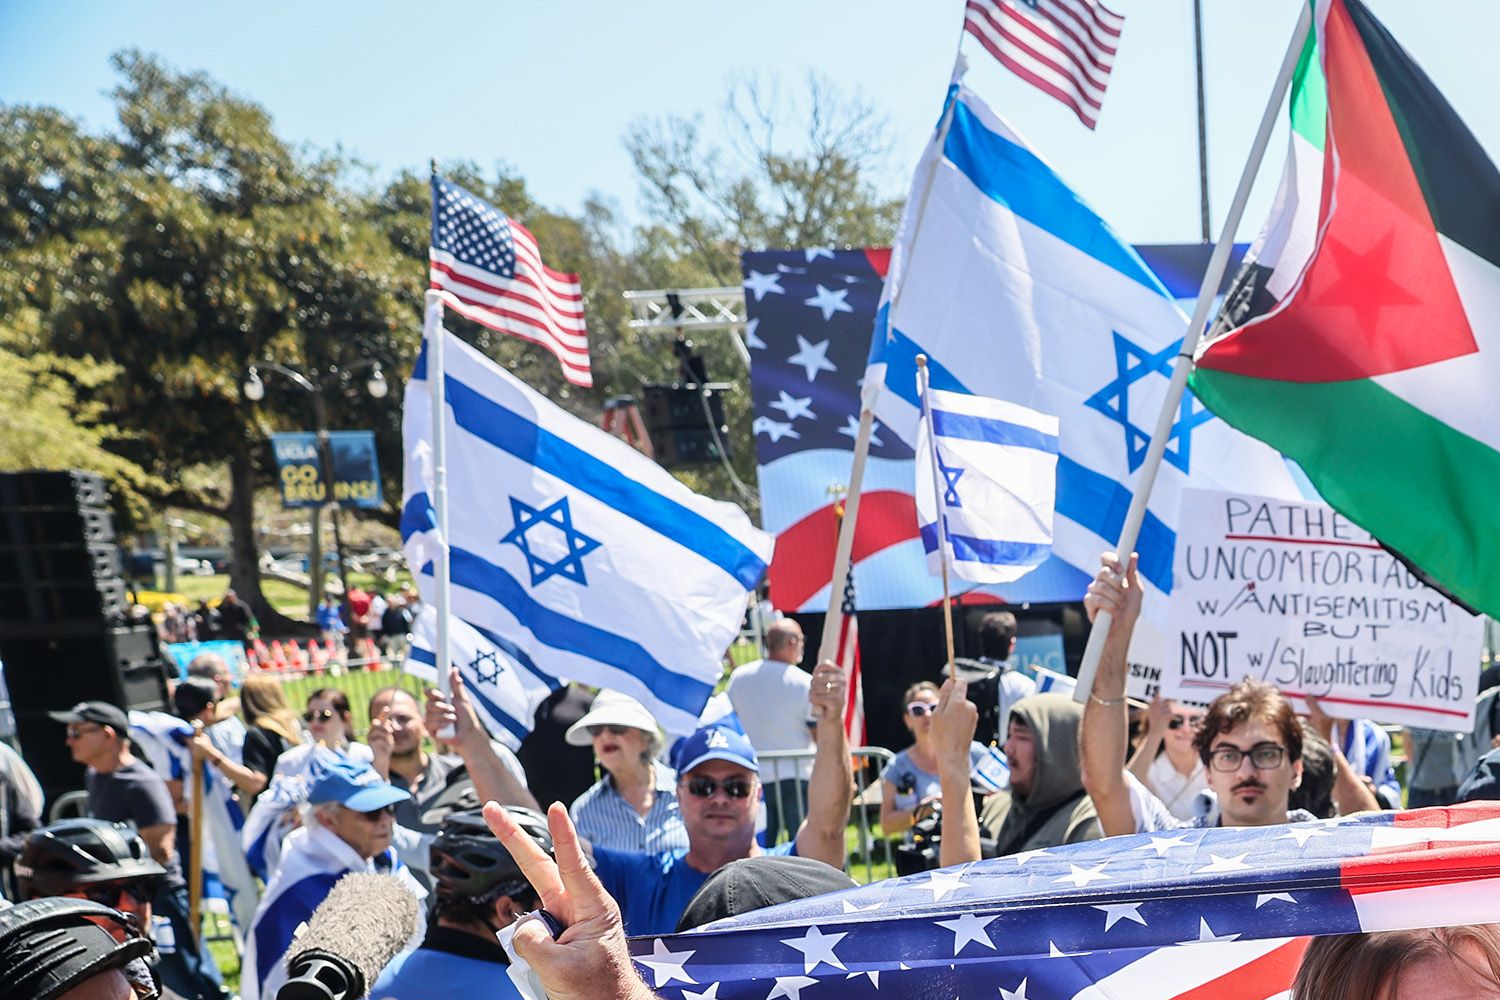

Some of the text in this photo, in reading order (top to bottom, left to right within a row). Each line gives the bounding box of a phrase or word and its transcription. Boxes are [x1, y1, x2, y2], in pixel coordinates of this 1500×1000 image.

[281, 464, 319, 483] GO
[1226, 498, 1376, 541] PATHE
[1303, 621, 1390, 641] BUT
[1181, 631, 1238, 678] NOT
[1409, 645, 1464, 701] Kids
[705, 729, 729, 749] LA
